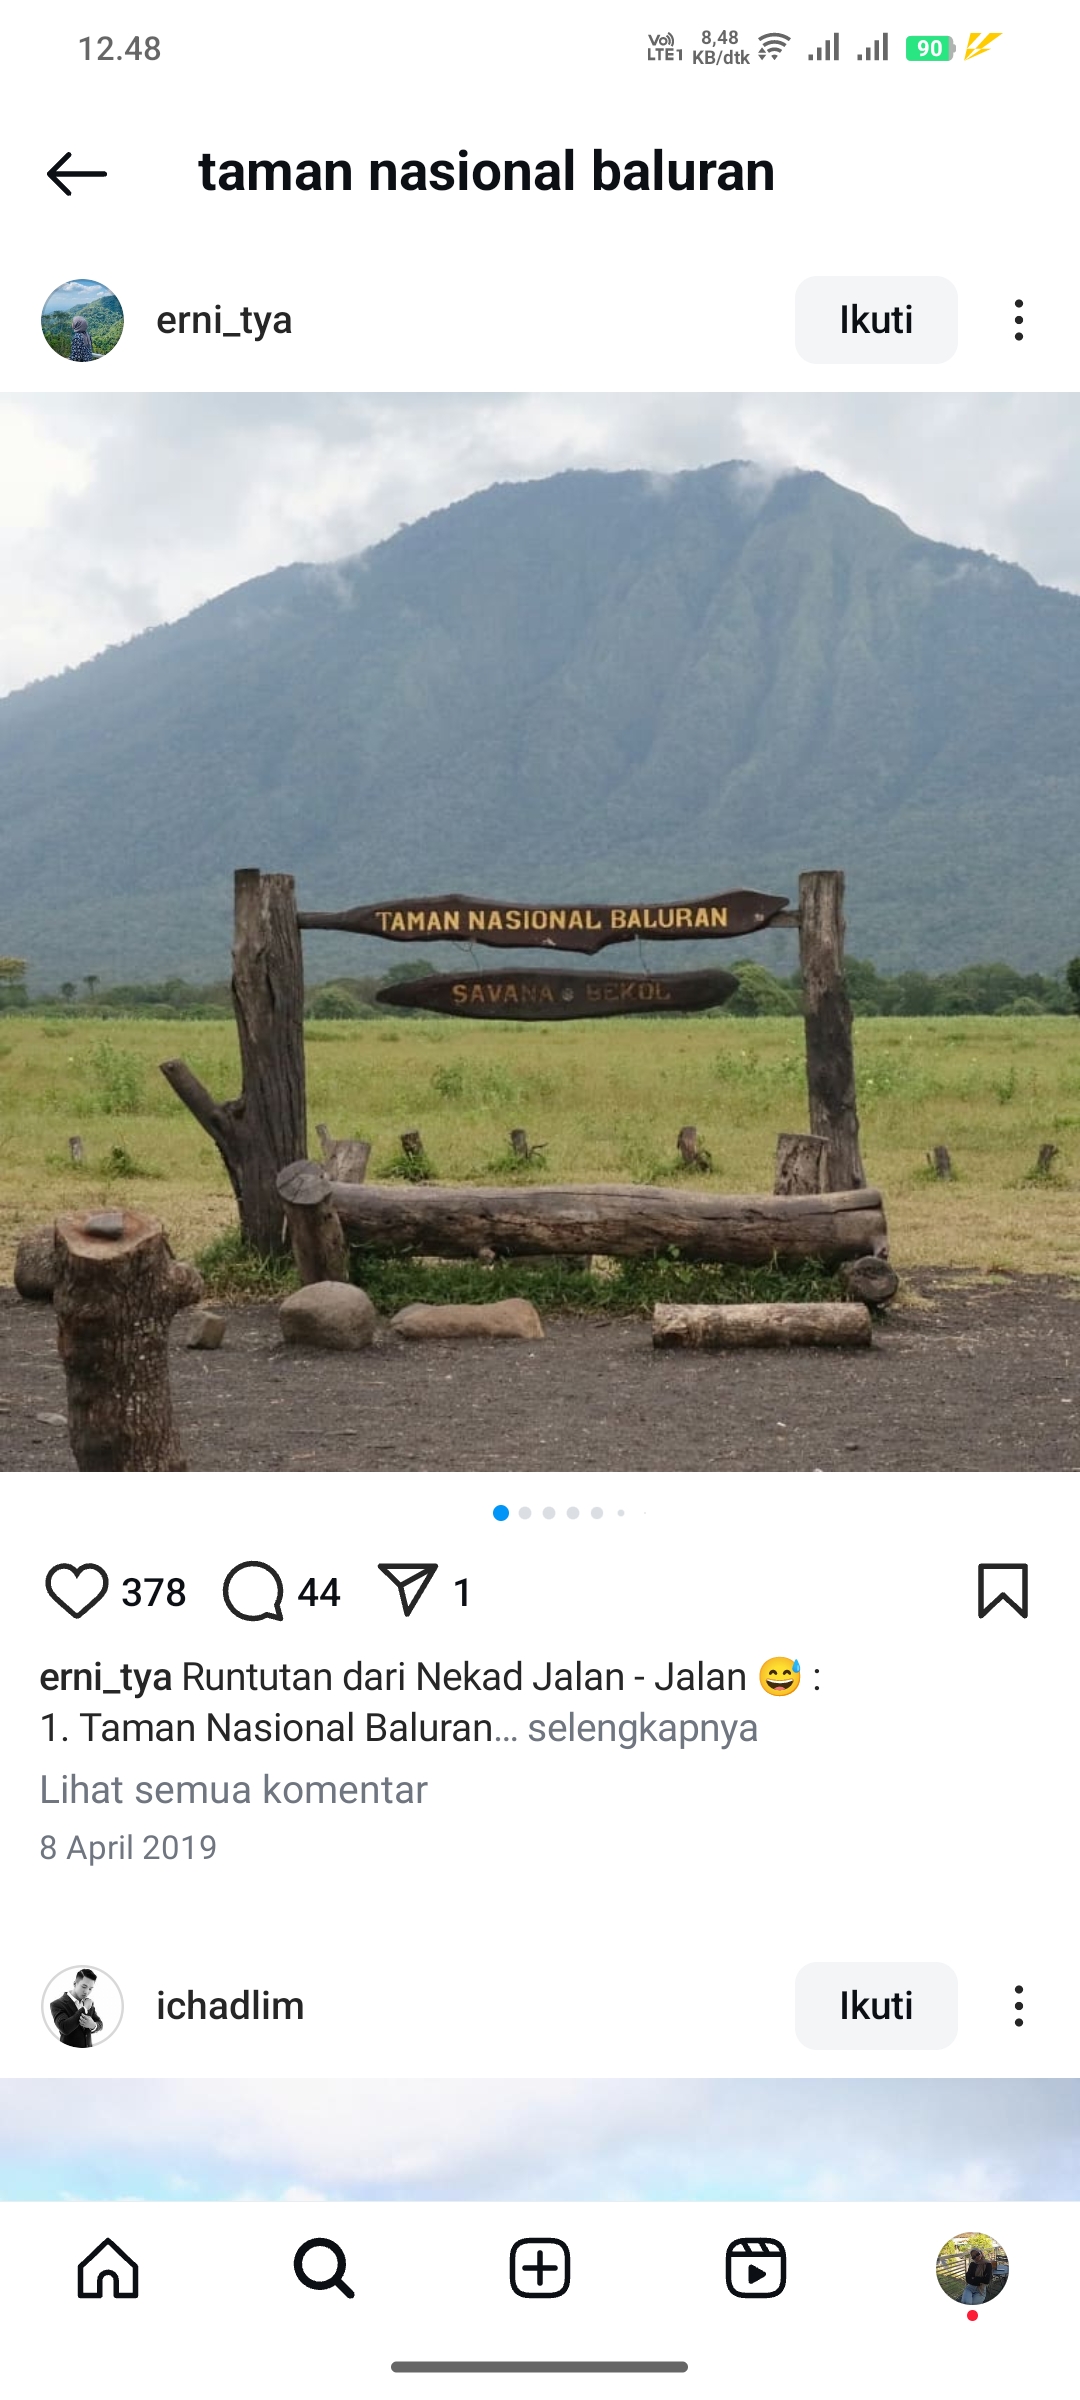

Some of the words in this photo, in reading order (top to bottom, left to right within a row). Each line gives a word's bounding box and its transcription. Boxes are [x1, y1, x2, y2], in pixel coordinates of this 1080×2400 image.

[79, 36, 160, 61] 12.48
[702, 30, 738, 46] 8,48
[917, 39, 943, 57] 90
[693, 49, 751, 66] KB/dtk
[198, 153, 351, 191] taman
[371, 148, 573, 191] nasional
[594, 148, 773, 191] baluran
[157, 304, 292, 342] erni_tya
[842, 303, 912, 334] Ikuti
[375, 910, 460, 932] TAMAN
[468, 910, 602, 931] NASIONAL
[611, 907, 728, 930] BALURAN
[452, 983, 554, 1003] SAVANA
[122, 1578, 186, 1607] 378
[298, 1578, 341, 1606] 44
[455, 1578, 467, 1606] 1
[40, 1661, 172, 1699] erni_tya
[184, 1662, 331, 1691] Runtutan
[343, 1660, 404, 1691] dari
[418, 1660, 522, 1691] Nekad
[533, 1660, 623, 1691] Jalan
[655, 1660, 745, 1691] Jalan
[42, 1713, 68, 1742] 1.
[80, 1713, 194, 1742] Taman
[208, 1711, 353, 1742] Nasional
[529, 1711, 757, 1750] selengkapnya
[42, 1773, 123, 1804] Lihat
[136, 1782, 250, 1804] semua
[264, 1773, 428, 1804] komentar
[41, 1835, 56, 1860] 8
[66, 1834, 132, 1866] April
[143, 1835, 217, 1860] 2019
[158, 1989, 303, 2020] ichadlim
[842, 1989, 912, 2020] Ikuti
